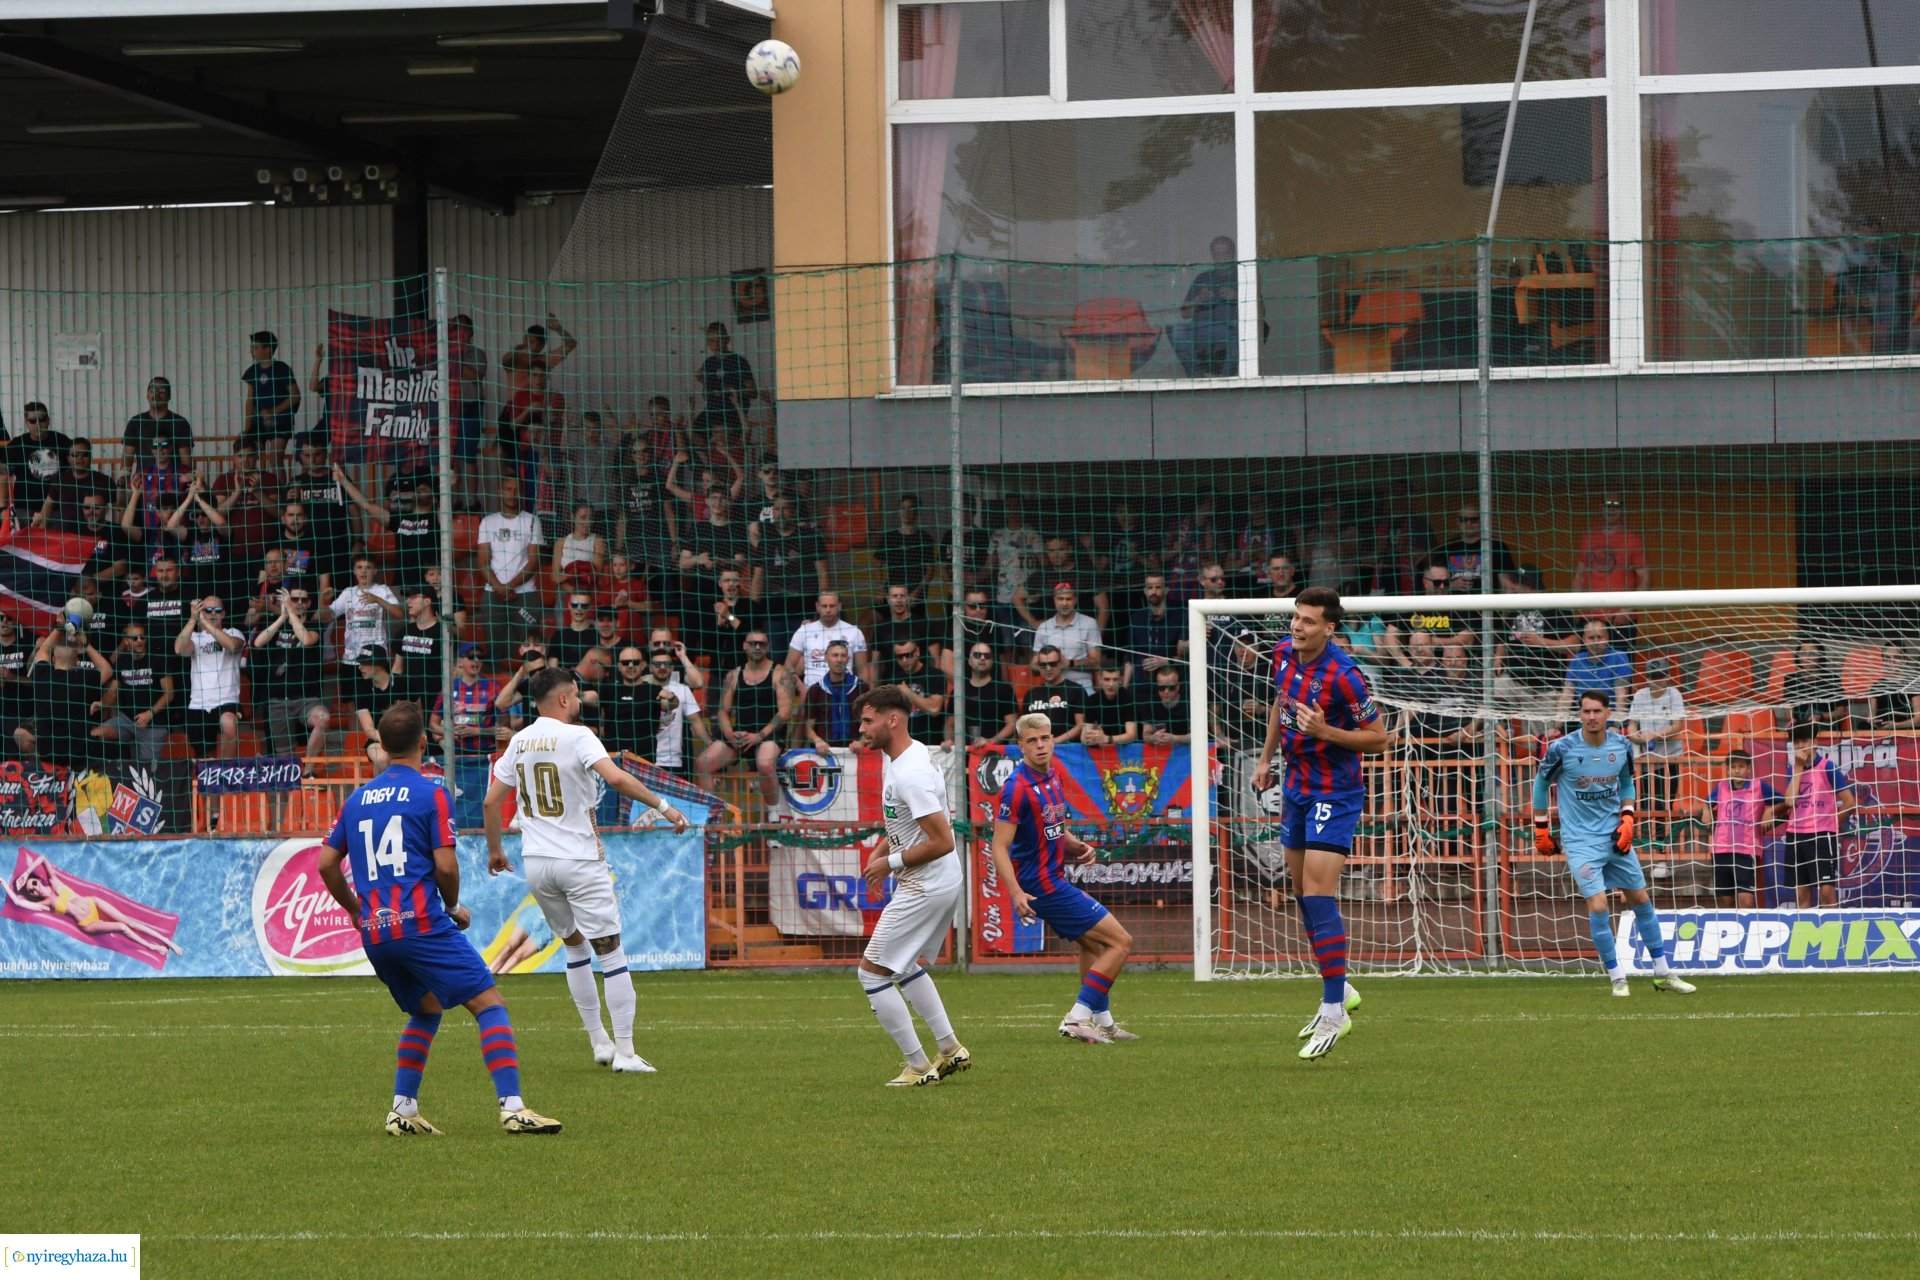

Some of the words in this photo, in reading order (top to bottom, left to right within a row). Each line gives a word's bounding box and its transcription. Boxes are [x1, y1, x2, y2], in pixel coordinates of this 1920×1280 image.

[364, 402, 430, 446] Family
[1425, 615, 1450, 628] 1928
[1029, 700, 1068, 712] ellesse
[515, 734, 558, 755] SZAKÁLY
[361, 787, 396, 806] NAGY
[397, 787, 410, 802] D.
[516, 761, 565, 818] 10
[112, 791, 136, 815] NY
[1315, 803, 1332, 820] 15
[136, 807, 154, 826] S
[359, 815, 407, 881] 14
[627, 951, 701, 965] uariusspa.hu
